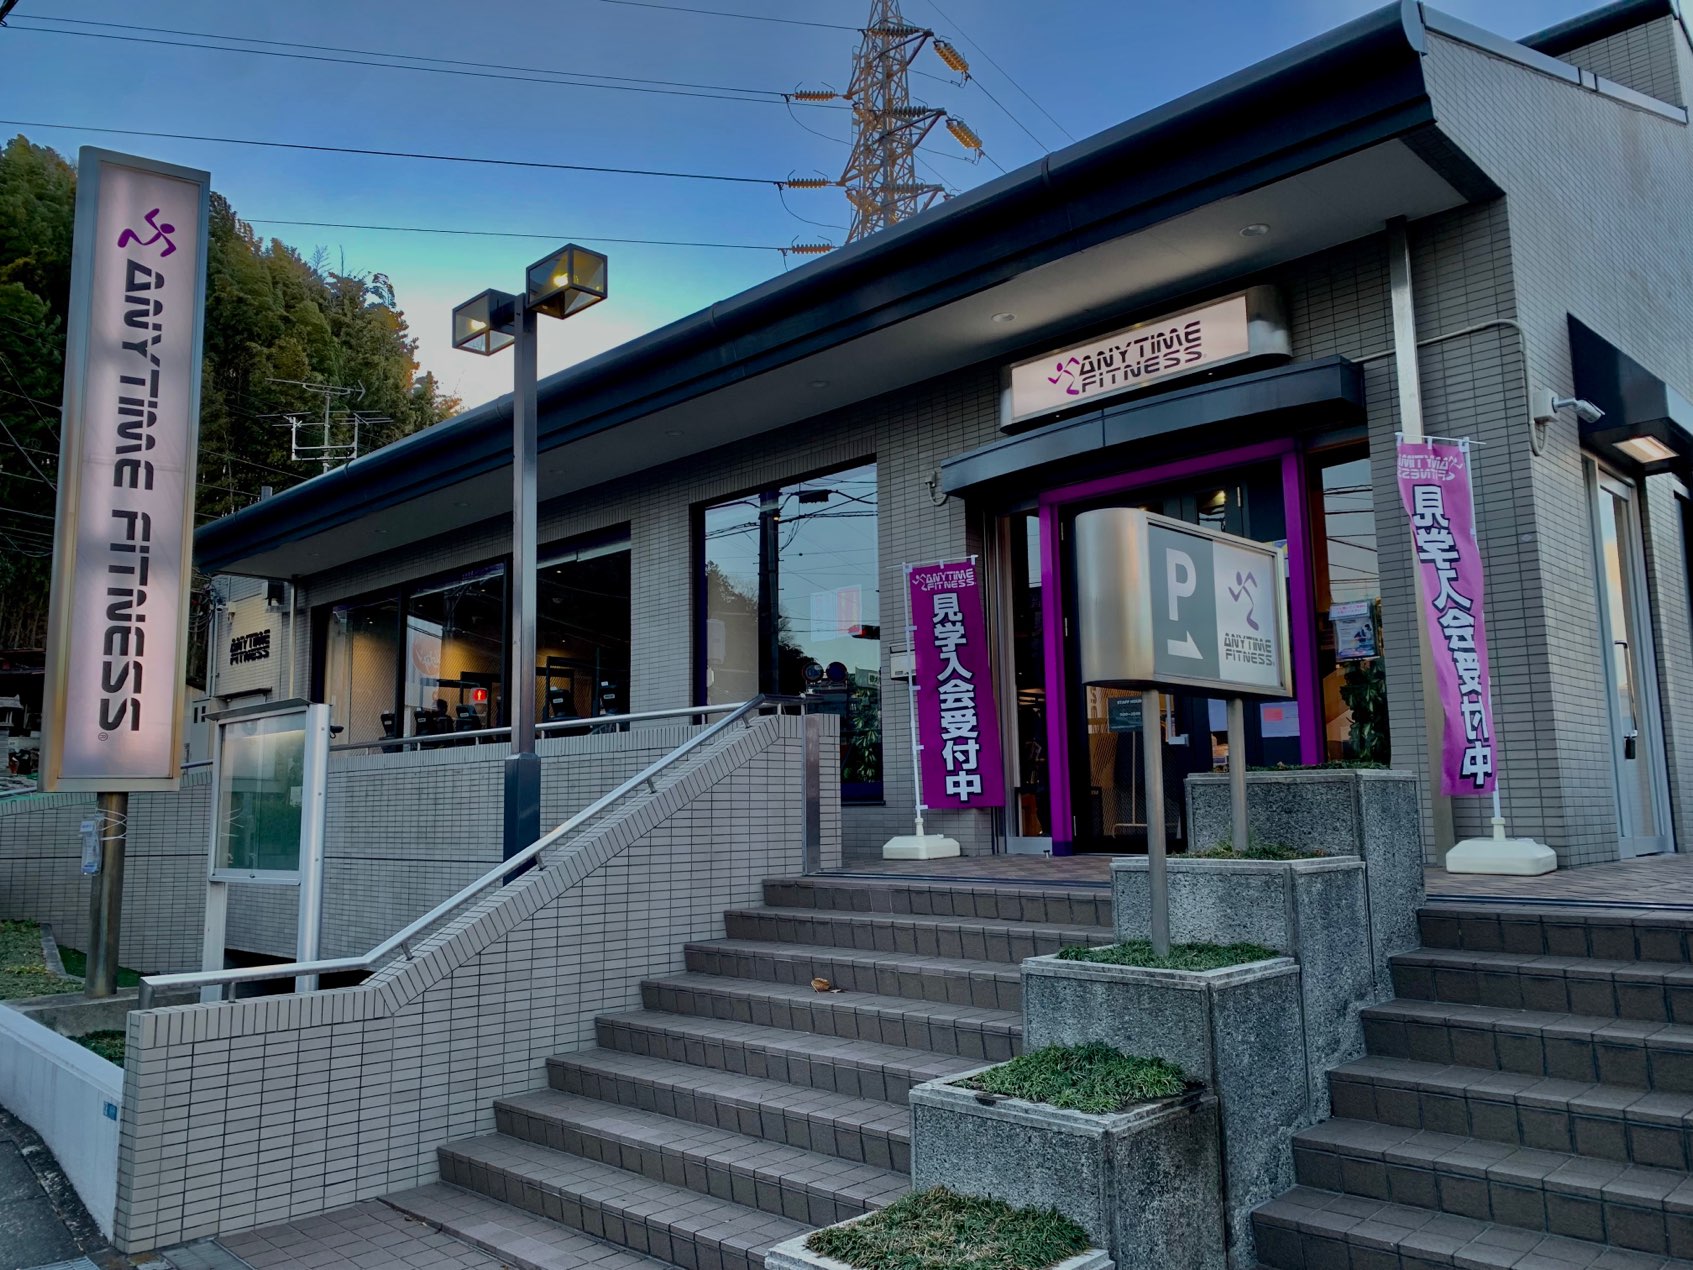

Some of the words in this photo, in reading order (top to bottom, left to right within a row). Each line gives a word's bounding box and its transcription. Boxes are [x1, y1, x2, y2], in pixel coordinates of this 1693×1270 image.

[1079, 320, 1202, 376] ANYTIME
[113, 258, 165, 491] ANYTIME
[1081, 343, 1203, 393] FITNESS
[925, 568, 974, 584] ANYTIME
[927, 577, 976, 591] FITNESS
[1166, 547, 1197, 622] P
[98, 508, 152, 732] FITNESS
[229, 628, 271, 653] ANYTIME
[229, 644, 271, 666] FITNESS
[1223, 632, 1273, 654] ANYTIME
[1225, 647, 1273, 667] FITNESS
[932, 592, 983, 802] 見学入会受付中
